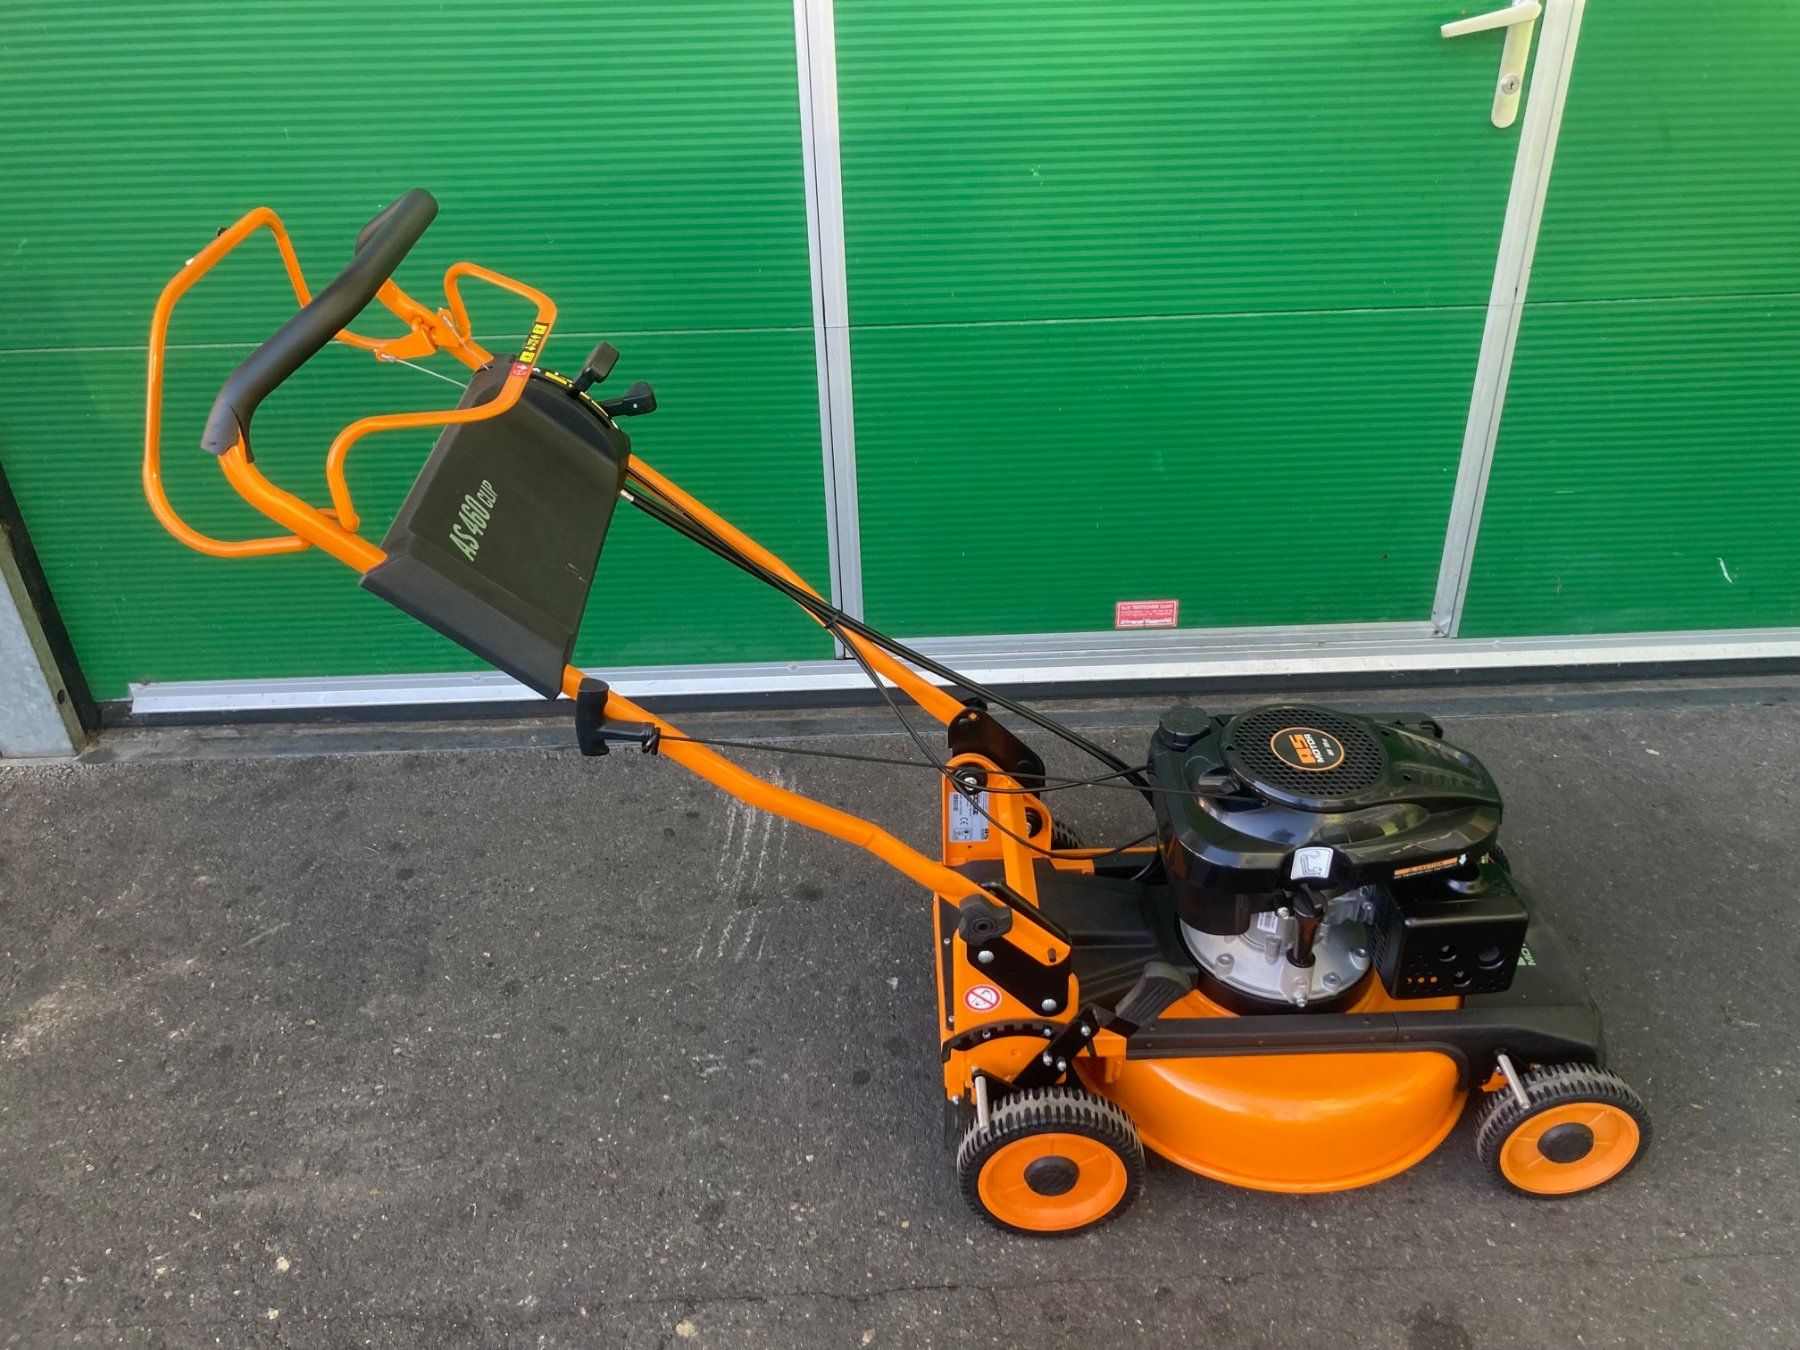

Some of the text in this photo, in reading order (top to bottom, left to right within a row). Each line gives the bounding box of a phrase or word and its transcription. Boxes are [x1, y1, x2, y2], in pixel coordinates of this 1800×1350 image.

[449, 479, 498, 562] AS 460 CLIP
[1288, 734, 1316, 763] AS
[1303, 733, 1325, 763] MOTOR
